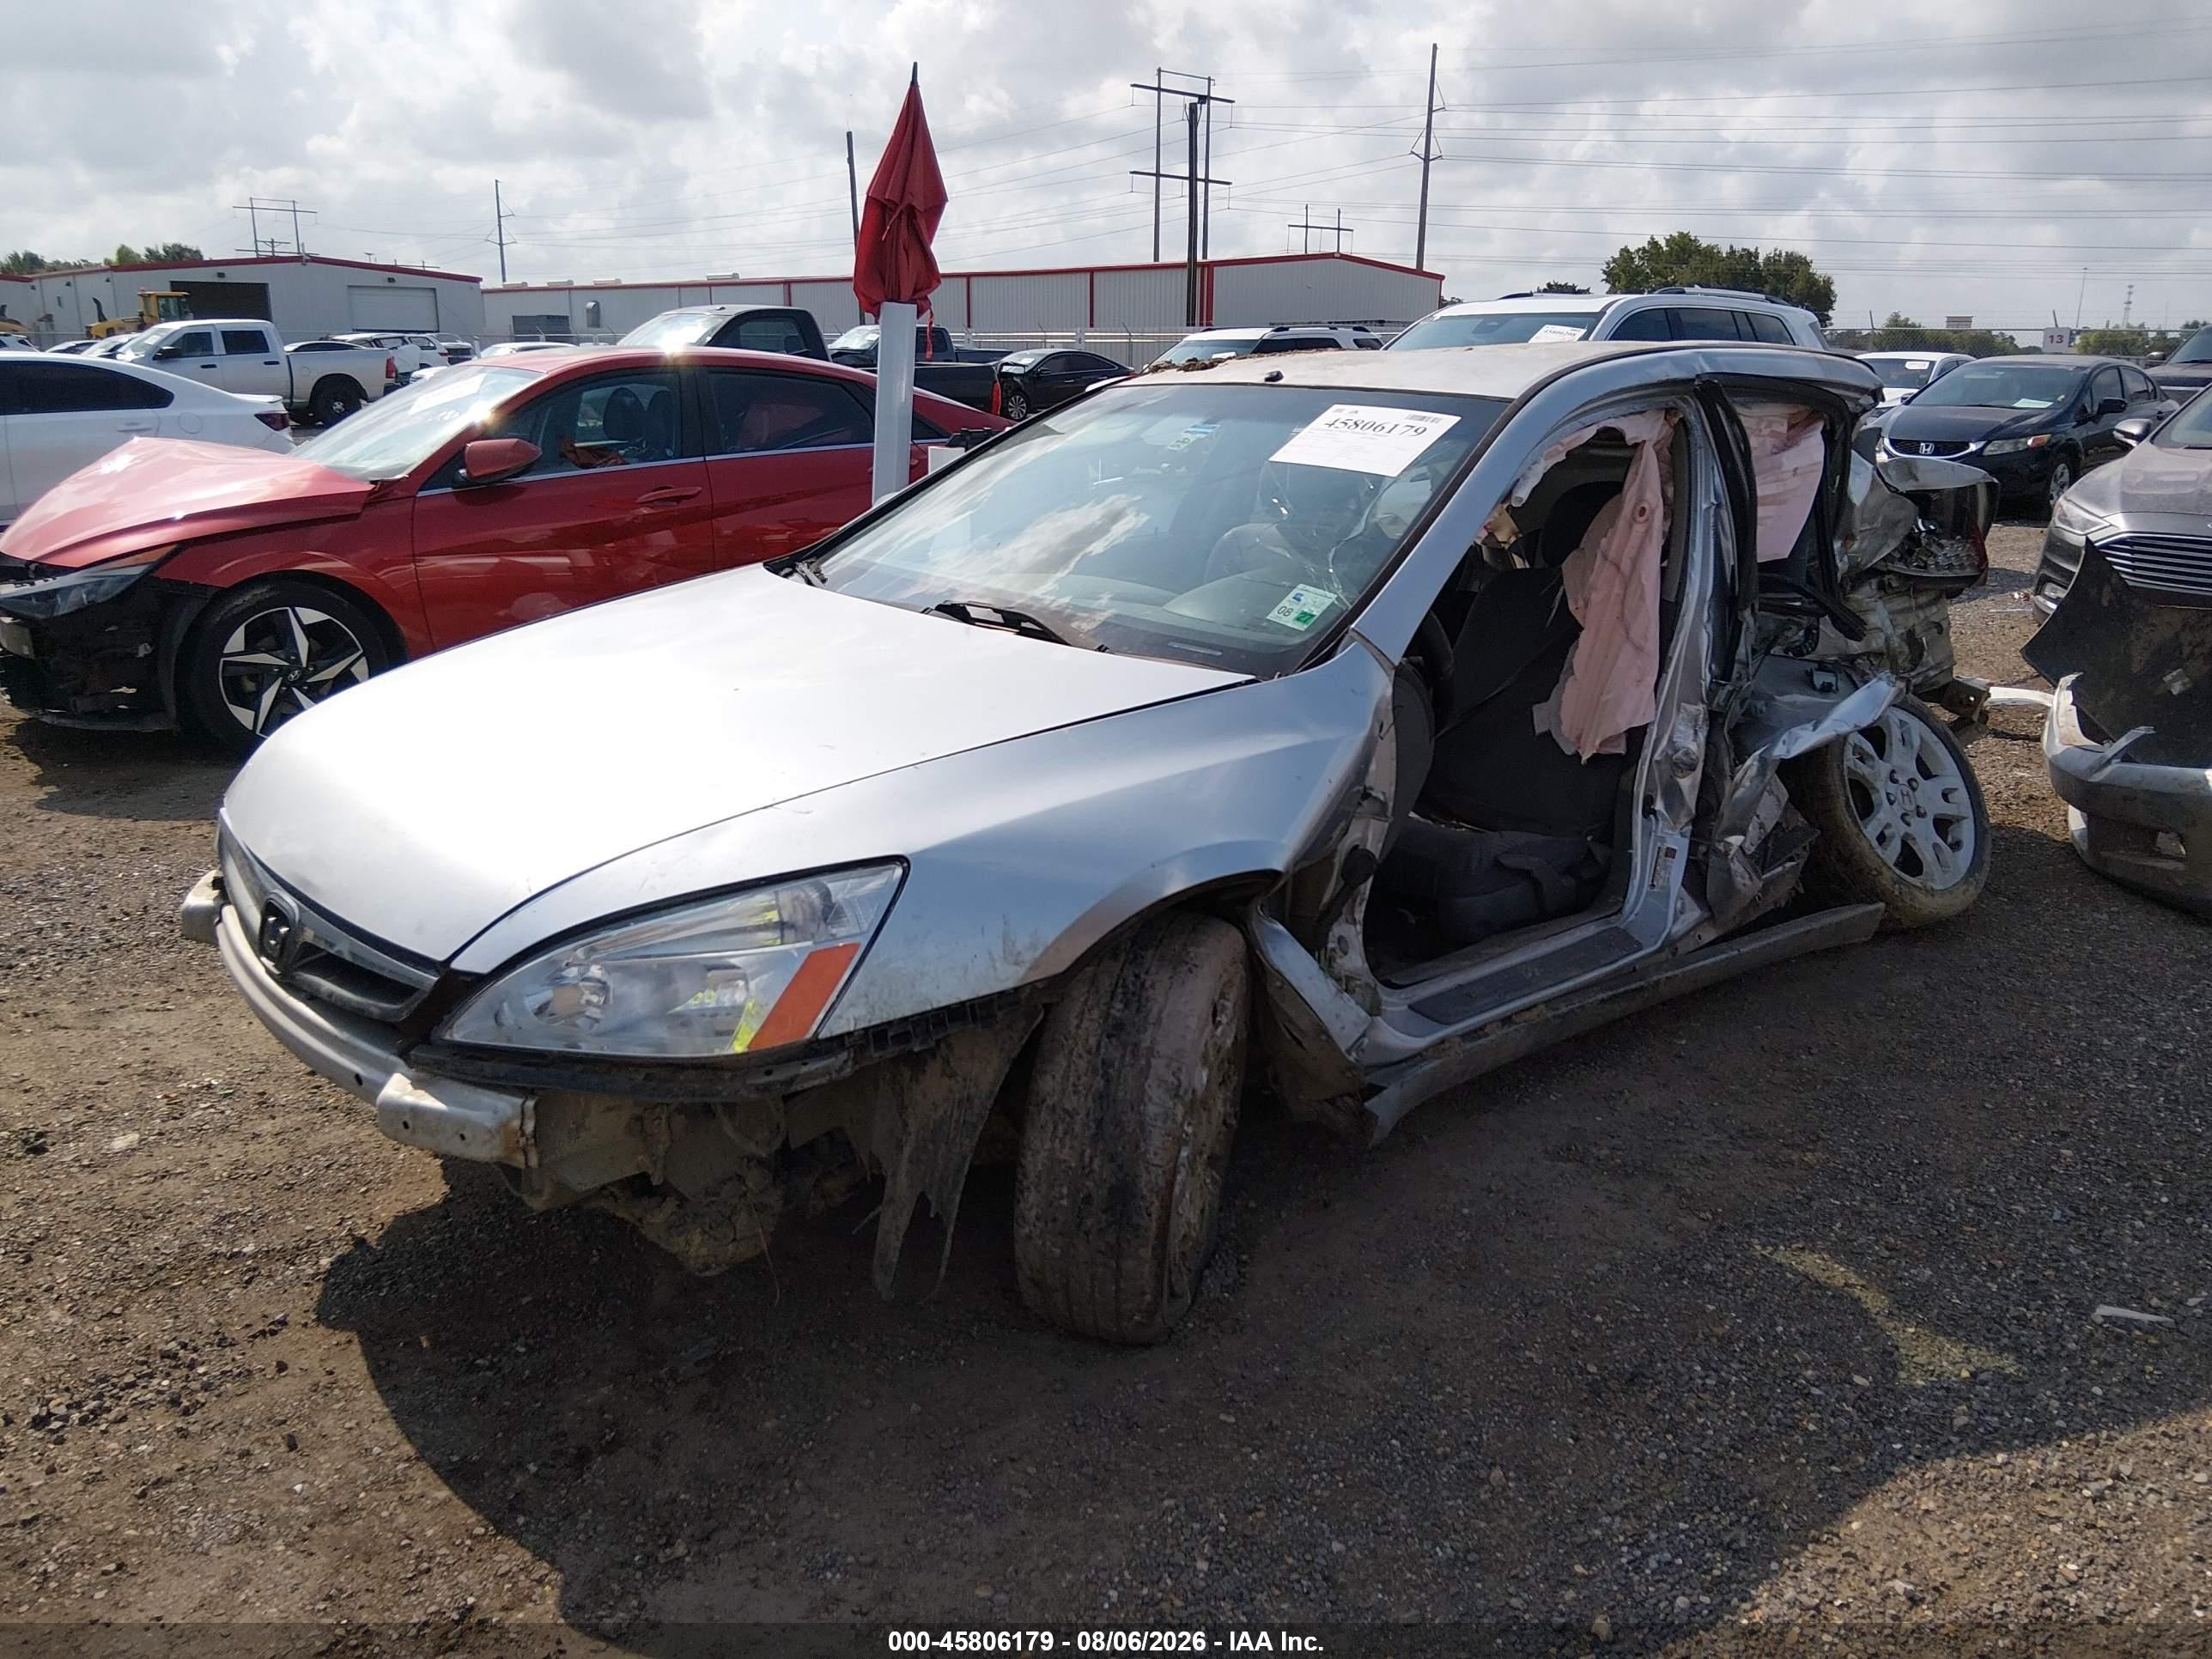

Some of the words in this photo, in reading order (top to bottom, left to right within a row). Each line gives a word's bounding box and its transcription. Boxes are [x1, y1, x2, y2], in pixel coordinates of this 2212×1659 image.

[2048, 334, 2063, 343] 13
[1324, 417, 1427, 436] 45806179
[1277, 605, 1293, 617] 08
